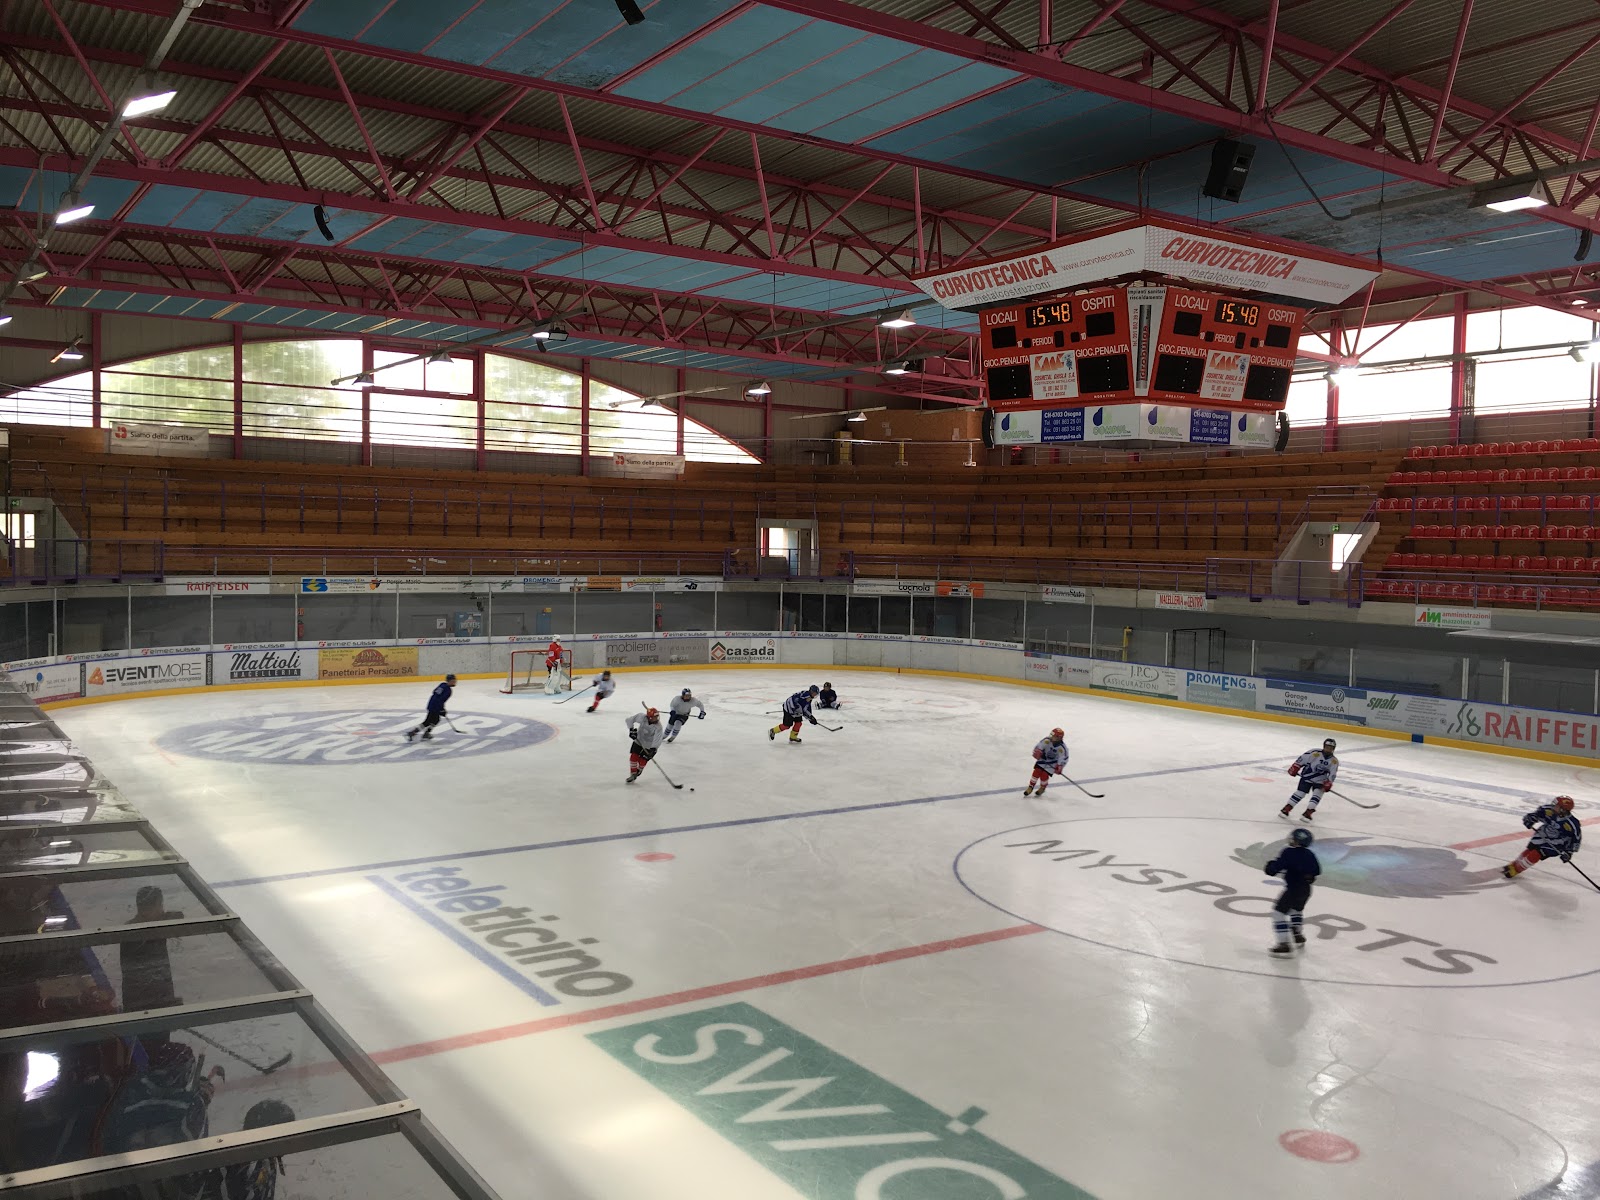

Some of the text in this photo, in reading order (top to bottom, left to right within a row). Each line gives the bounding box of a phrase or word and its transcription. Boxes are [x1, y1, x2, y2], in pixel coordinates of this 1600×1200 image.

[1061, 247, 1136, 271] www.curvotecnica.ch
[1161, 237, 1299, 280] CURVOTECNICA
[932, 254, 1058, 299] CURVOTECNICA
[1188, 268, 1270, 289] metalcostruzioni
[974, 281, 1051, 303] metalcostruzioni
[1081, 295, 1116, 311] OSPITI
[1175, 295, 1210, 311] LOCALI
[986, 310, 1018, 326] LOCALI
[1032, 302, 1071, 326] 15:48
[1221, 303, 1259, 325] 15:48
[1268, 308, 1297, 323] OSPITI
[1032, 336, 1054, 346] PERIODI
[1214, 333, 1236, 344] PERIODI
[152, 432, 168, 440] della
[187, 582, 249, 591] RAIFFEISEN
[1159, 594, 1184, 605] MACELLERIA
[1188, 595, 1203, 608] CENTRO
[1442, 611, 1491, 619] amministrazioni
[607, 642, 657, 653] mobilerre
[726, 646, 775, 656] casada
[231, 651, 301, 671] Mattioli
[106, 662, 202, 682] EVENTMORE
[233, 669, 298, 678] MACELLERIA
[322, 666, 414, 677] Panetteria Persico SA
[1106, 678, 1159, 690] ASSICURAZIONI
[1186, 671, 1247, 691] PROMENG
[1247, 682, 1257, 690] SA
[1284, 691, 1308, 701] Garage
[1284, 699, 1304, 708] Weber
[1309, 703, 1335, 713] Monaco
[1335, 703, 1345, 713] SA
[1004, 839, 1501, 976] MYSPORTS
[398, 866, 634, 999] teleticino
